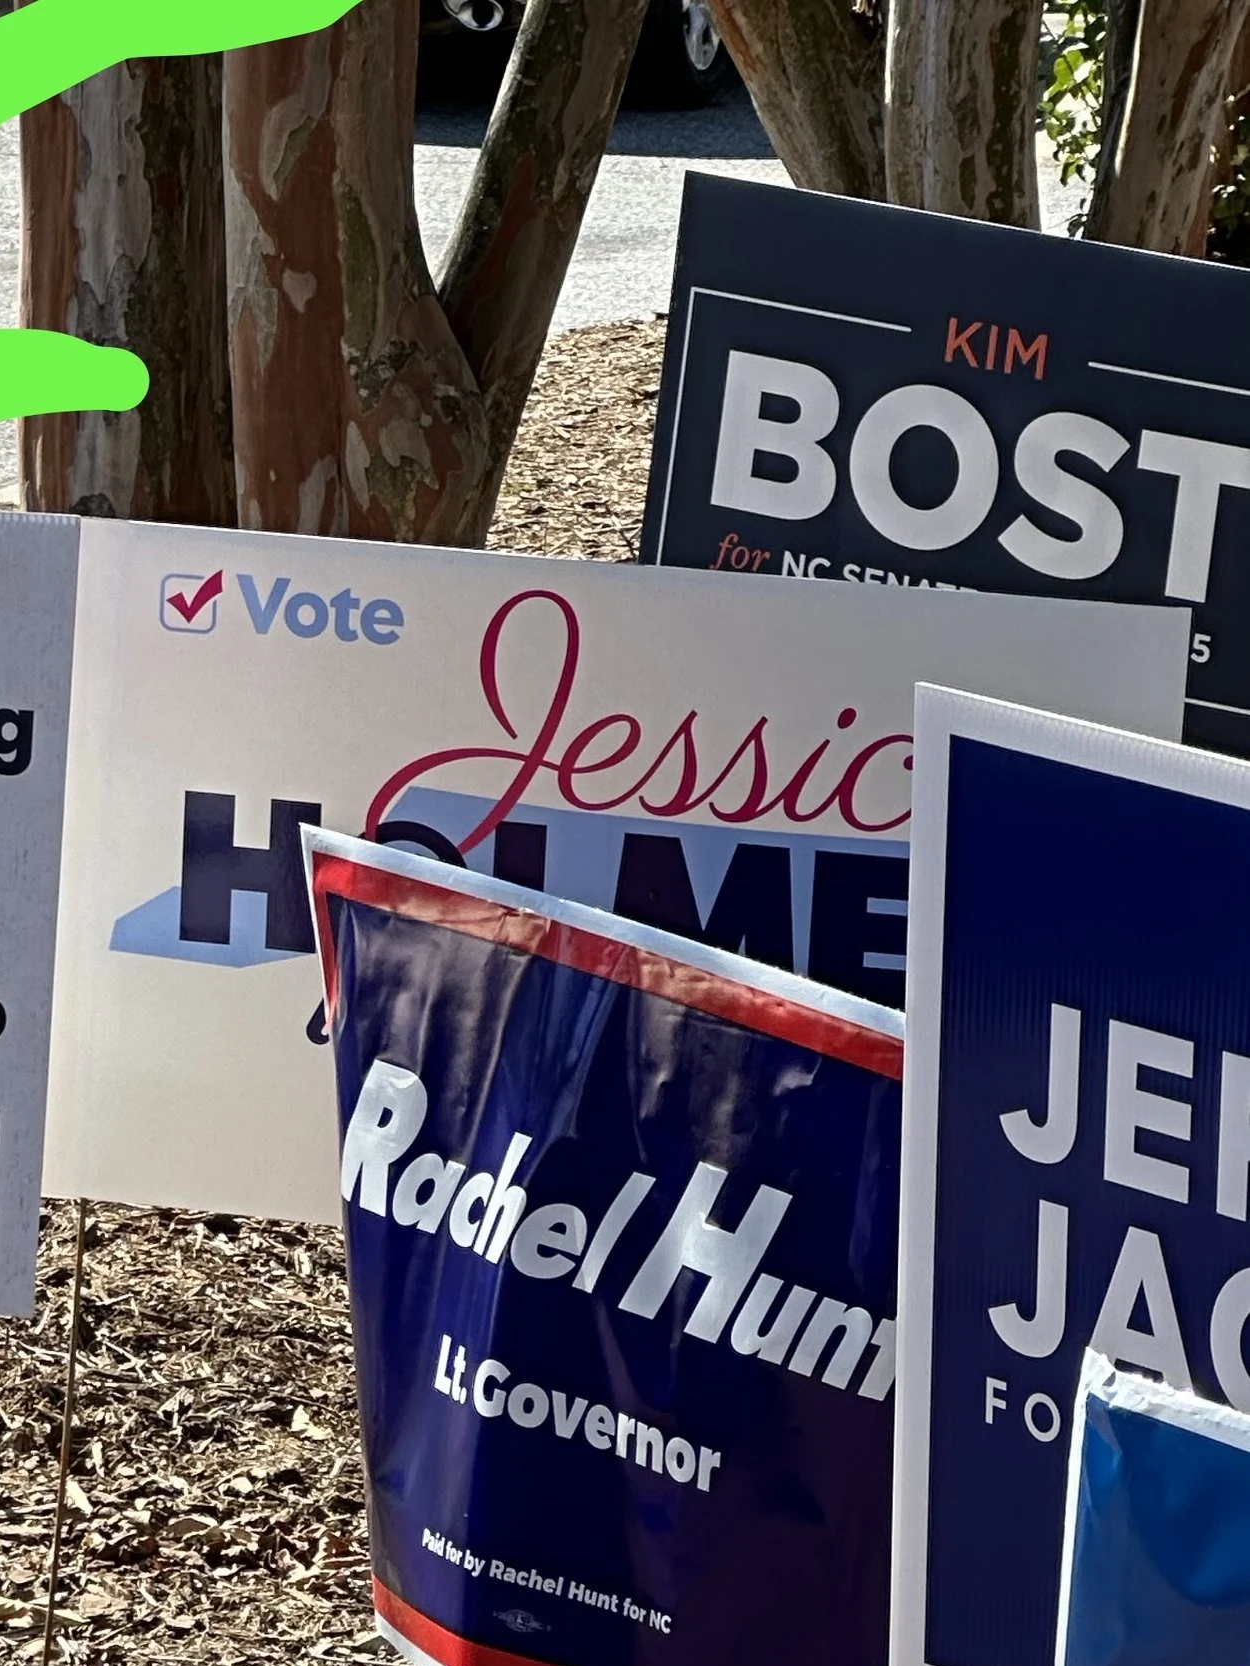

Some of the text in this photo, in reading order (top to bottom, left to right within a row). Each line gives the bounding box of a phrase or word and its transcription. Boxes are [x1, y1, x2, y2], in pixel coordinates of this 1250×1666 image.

[945, 317, 1049, 380] KIM
[710, 533, 771, 571] for
[236, 574, 404, 645] Vote
[340, 1058, 657, 1294] Rachel
[434, 1334, 721, 1492] Lt. Governor
[421, 1528, 672, 1634] Paid for by Rachel Hunt for NC
